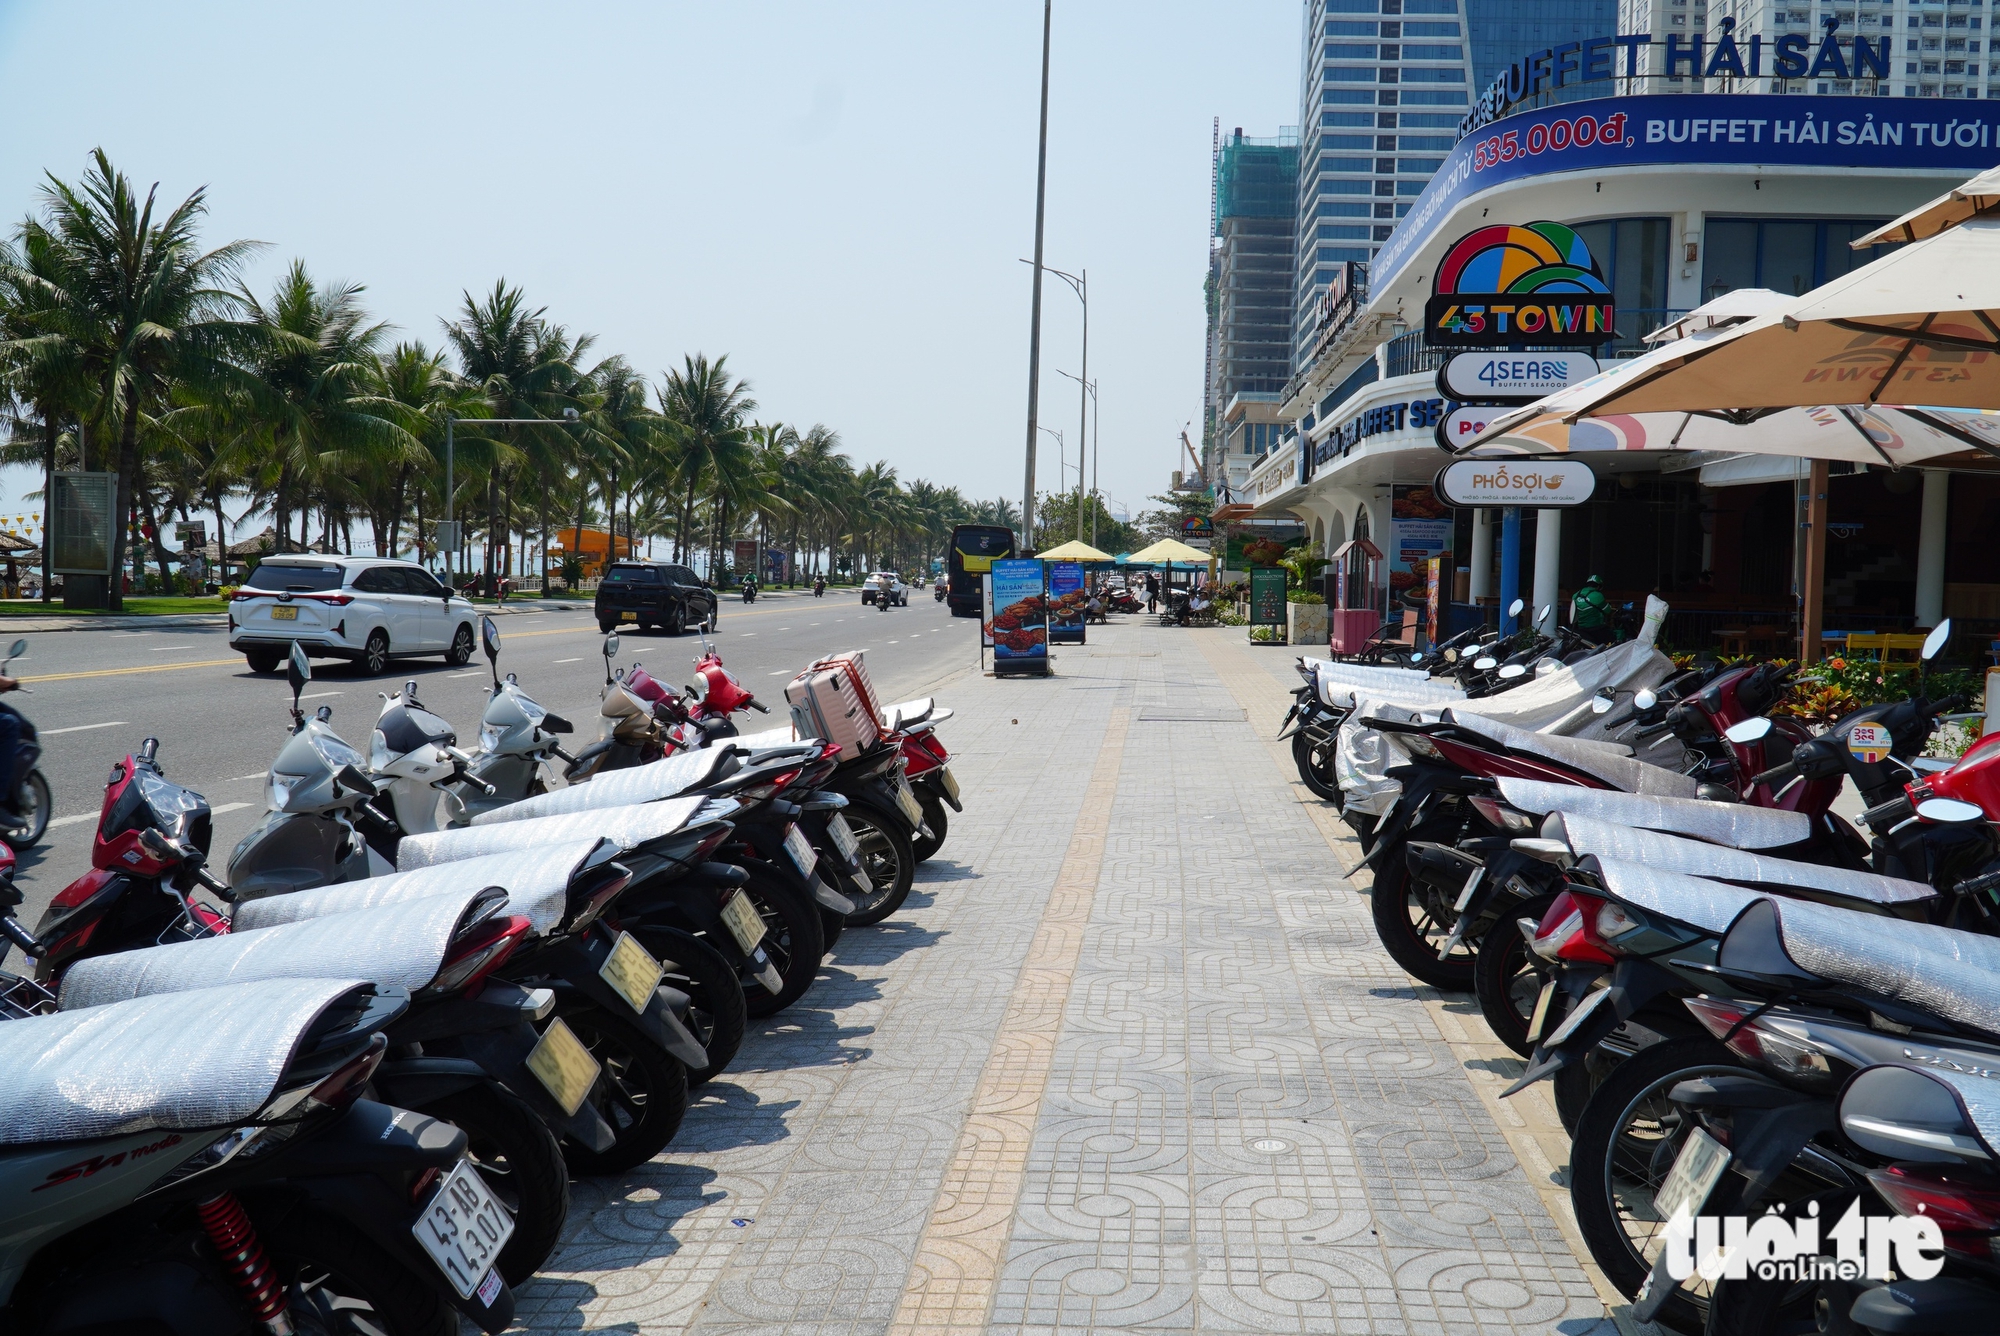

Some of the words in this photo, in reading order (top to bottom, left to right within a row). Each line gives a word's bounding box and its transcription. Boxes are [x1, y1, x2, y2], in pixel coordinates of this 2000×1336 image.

[1495, 34, 1651, 114] BUFFET
[1665, 17, 1760, 79] HẢI
[1774, 18, 1891, 79] SẢN
[1447, 159, 1458, 195] CHỈ
[1459, 150, 1473, 183] TỪ
[1646, 119, 1767, 144] BUFFET
[1774, 112, 1829, 145] HẢI
[1836, 113, 1903, 146] SẢN
[1911, 119, 1988, 148] TƯƠI
[1360, 403, 1408, 438] BUFFET
[1512, 473, 1542, 493] SỢI
[1009, 583, 1022, 591] SẢN
[606, 941, 640, 983] 43-E1
[380, 1111, 408, 1140] HONDA
[131, 1134, 183, 1161] mode
[427, 1176, 481, 1246] 43-AB
[446, 1199, 505, 1287] 143.07
